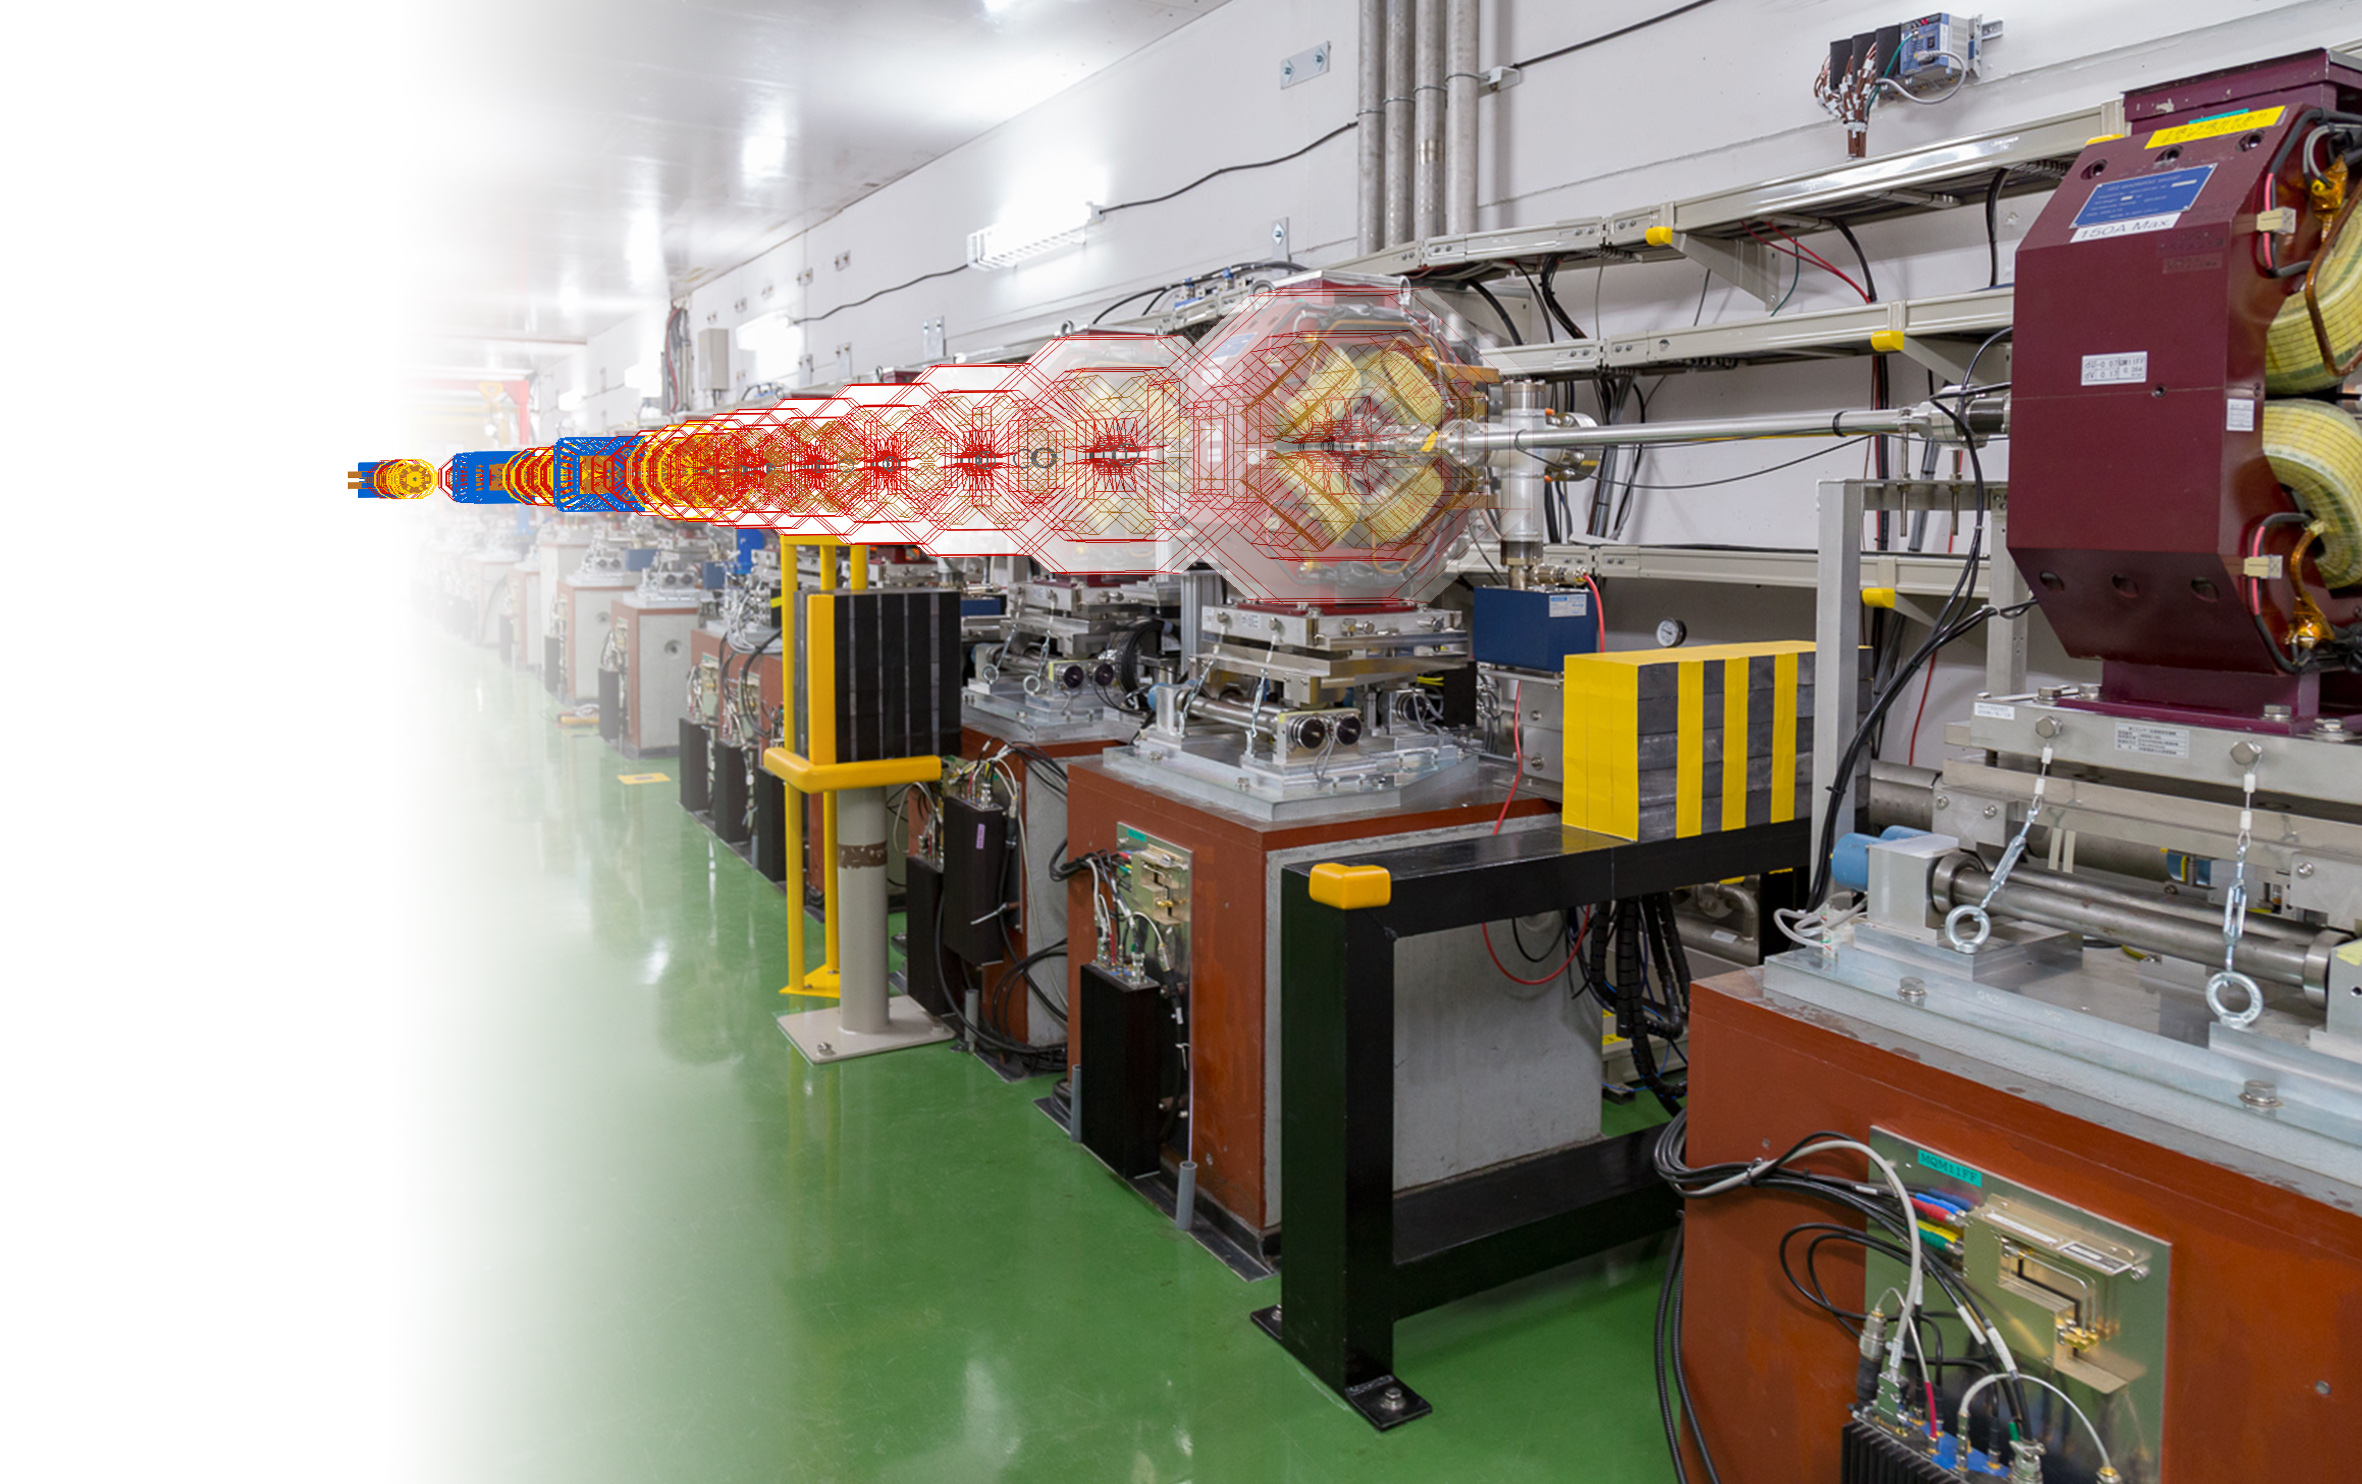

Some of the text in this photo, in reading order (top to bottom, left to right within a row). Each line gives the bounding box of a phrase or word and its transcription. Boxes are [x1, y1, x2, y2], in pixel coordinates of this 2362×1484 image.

[2080, 218, 2171, 239] 150A Max
[1920, 1152, 1979, 1183] MQM11FF
